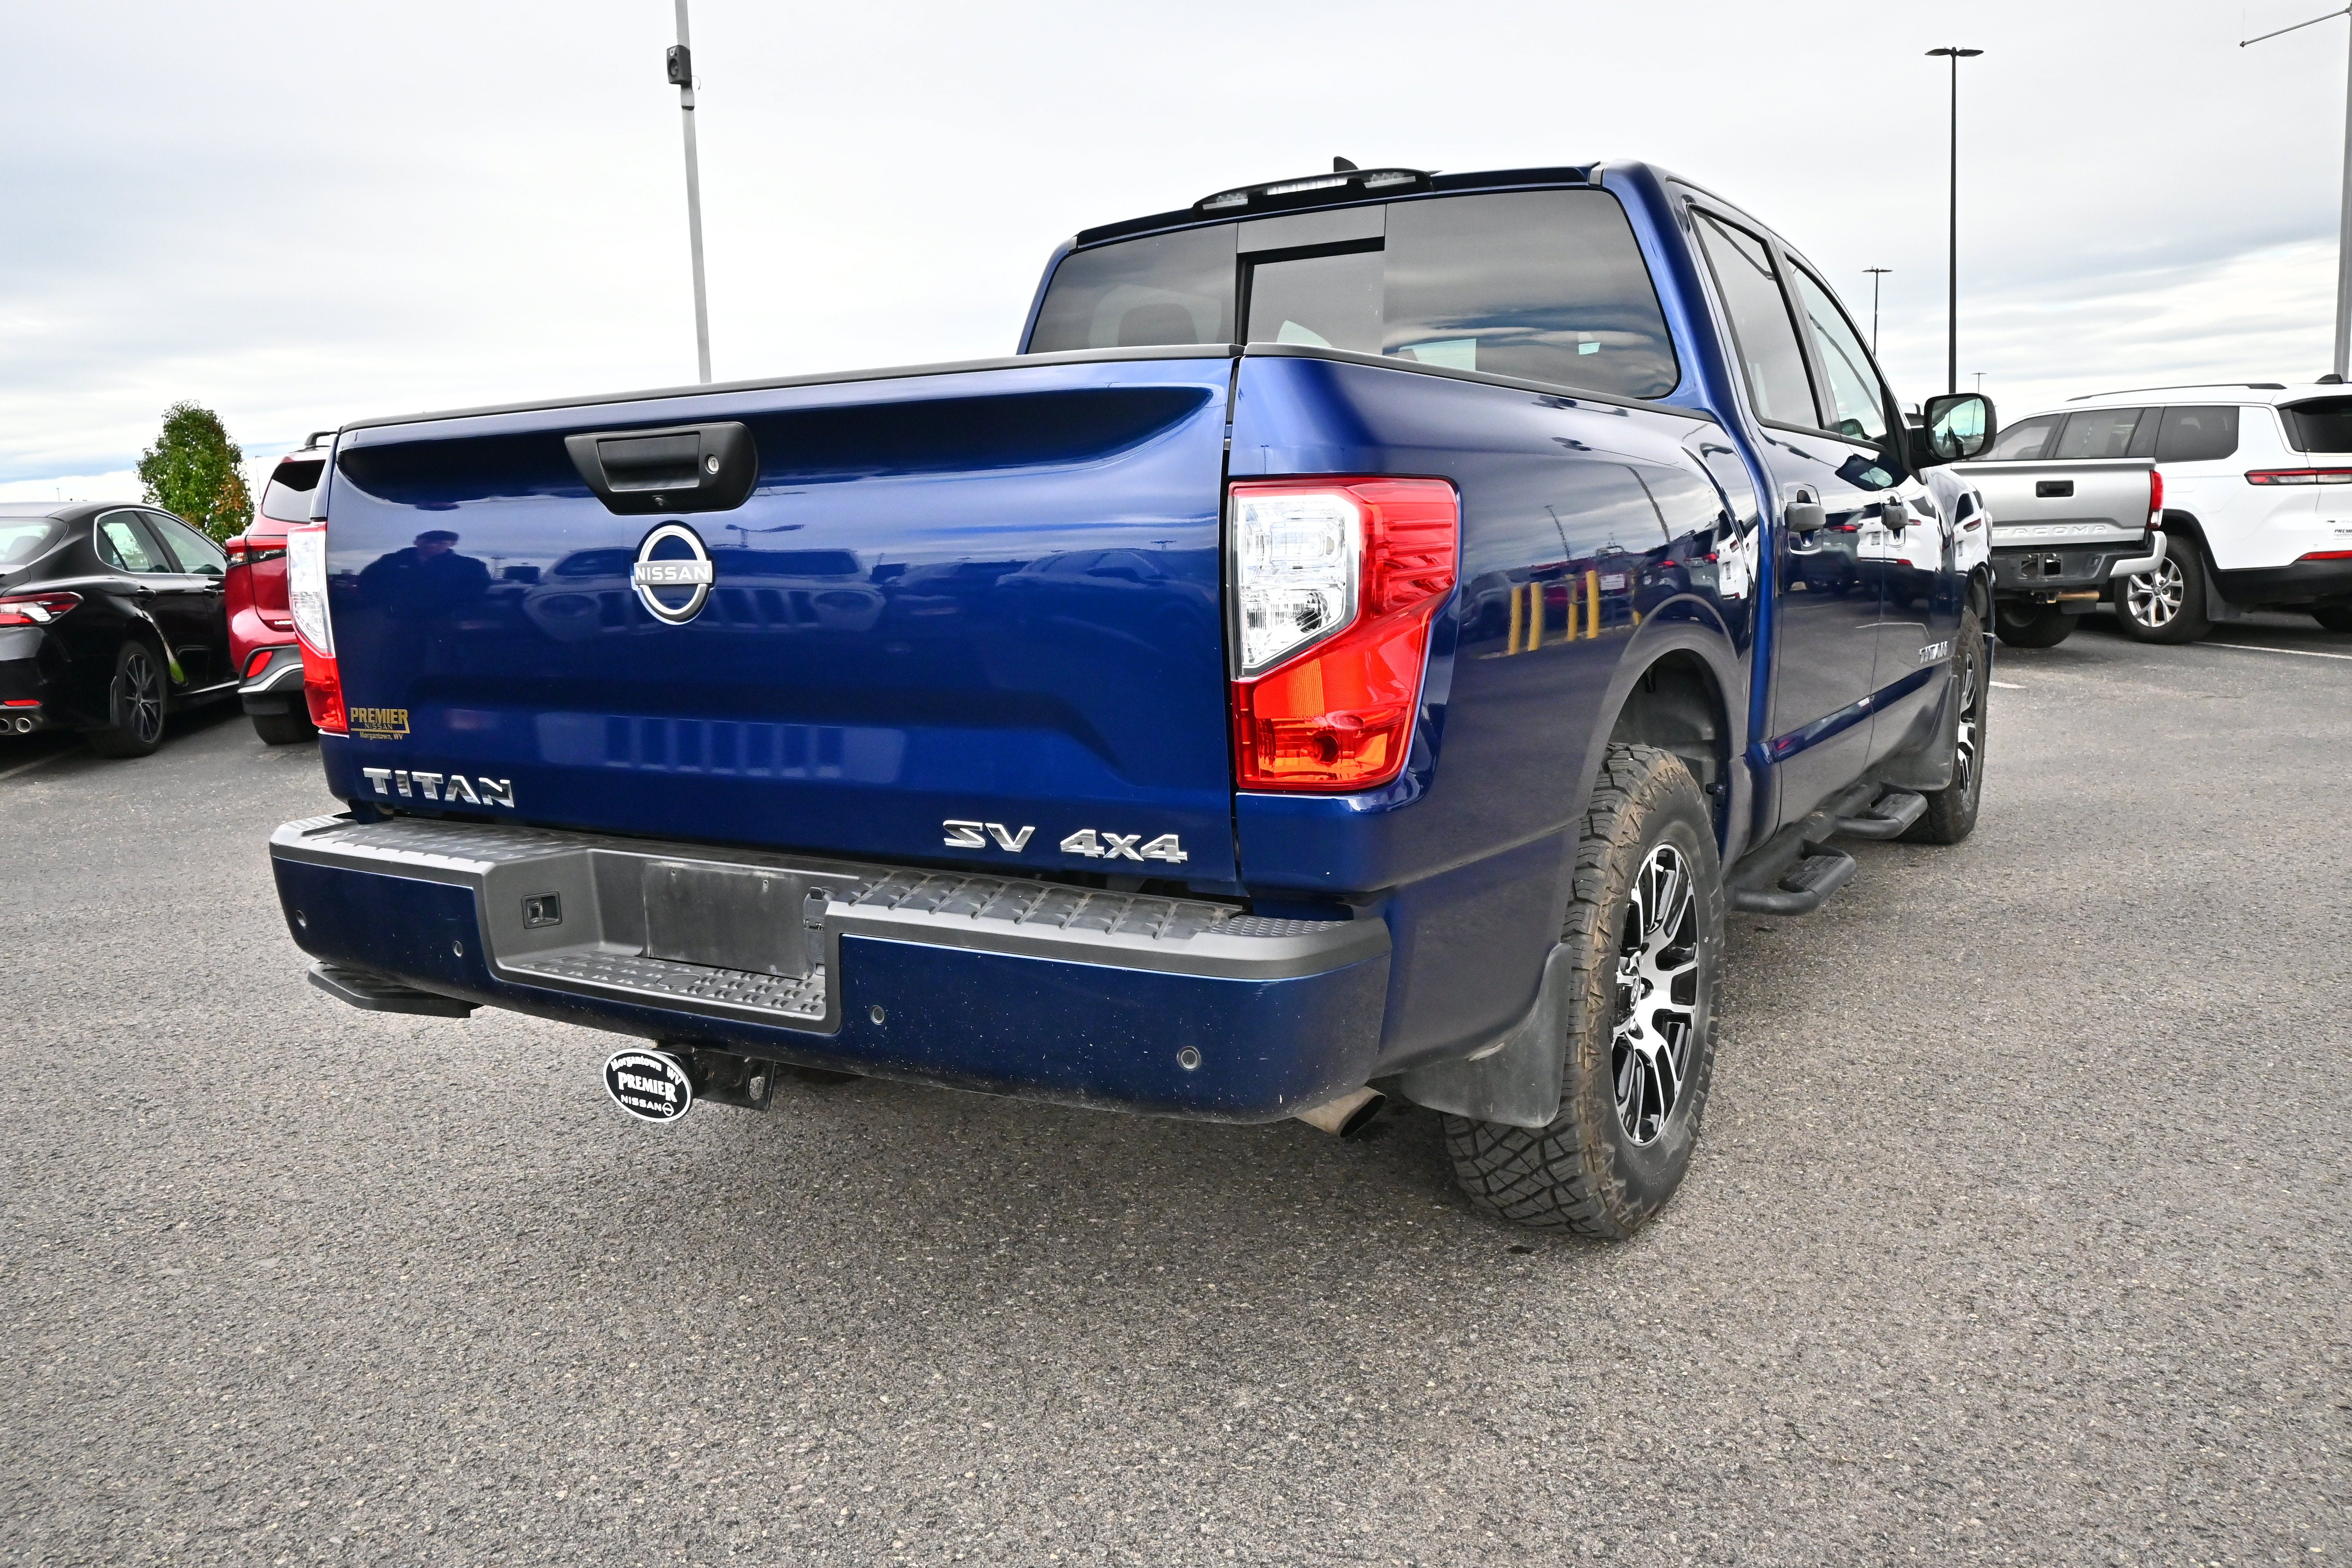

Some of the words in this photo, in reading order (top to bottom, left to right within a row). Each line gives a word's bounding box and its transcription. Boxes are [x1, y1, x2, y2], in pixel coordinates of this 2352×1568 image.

[1992, 525, 2107, 538] TACOMA
[635, 566, 709, 580] NISSAN
[350, 708, 409, 727] PREMIER
[359, 732, 392, 740] Morgantown,
[362, 767, 514, 808] TITAN
[942, 819, 1036, 853] SV
[610, 1056, 662, 1072] Morgantown
[666, 1066, 683, 1086] WV
[617, 1071, 678, 1102] PREMIER
[620, 1094, 662, 1112] NISSAN
